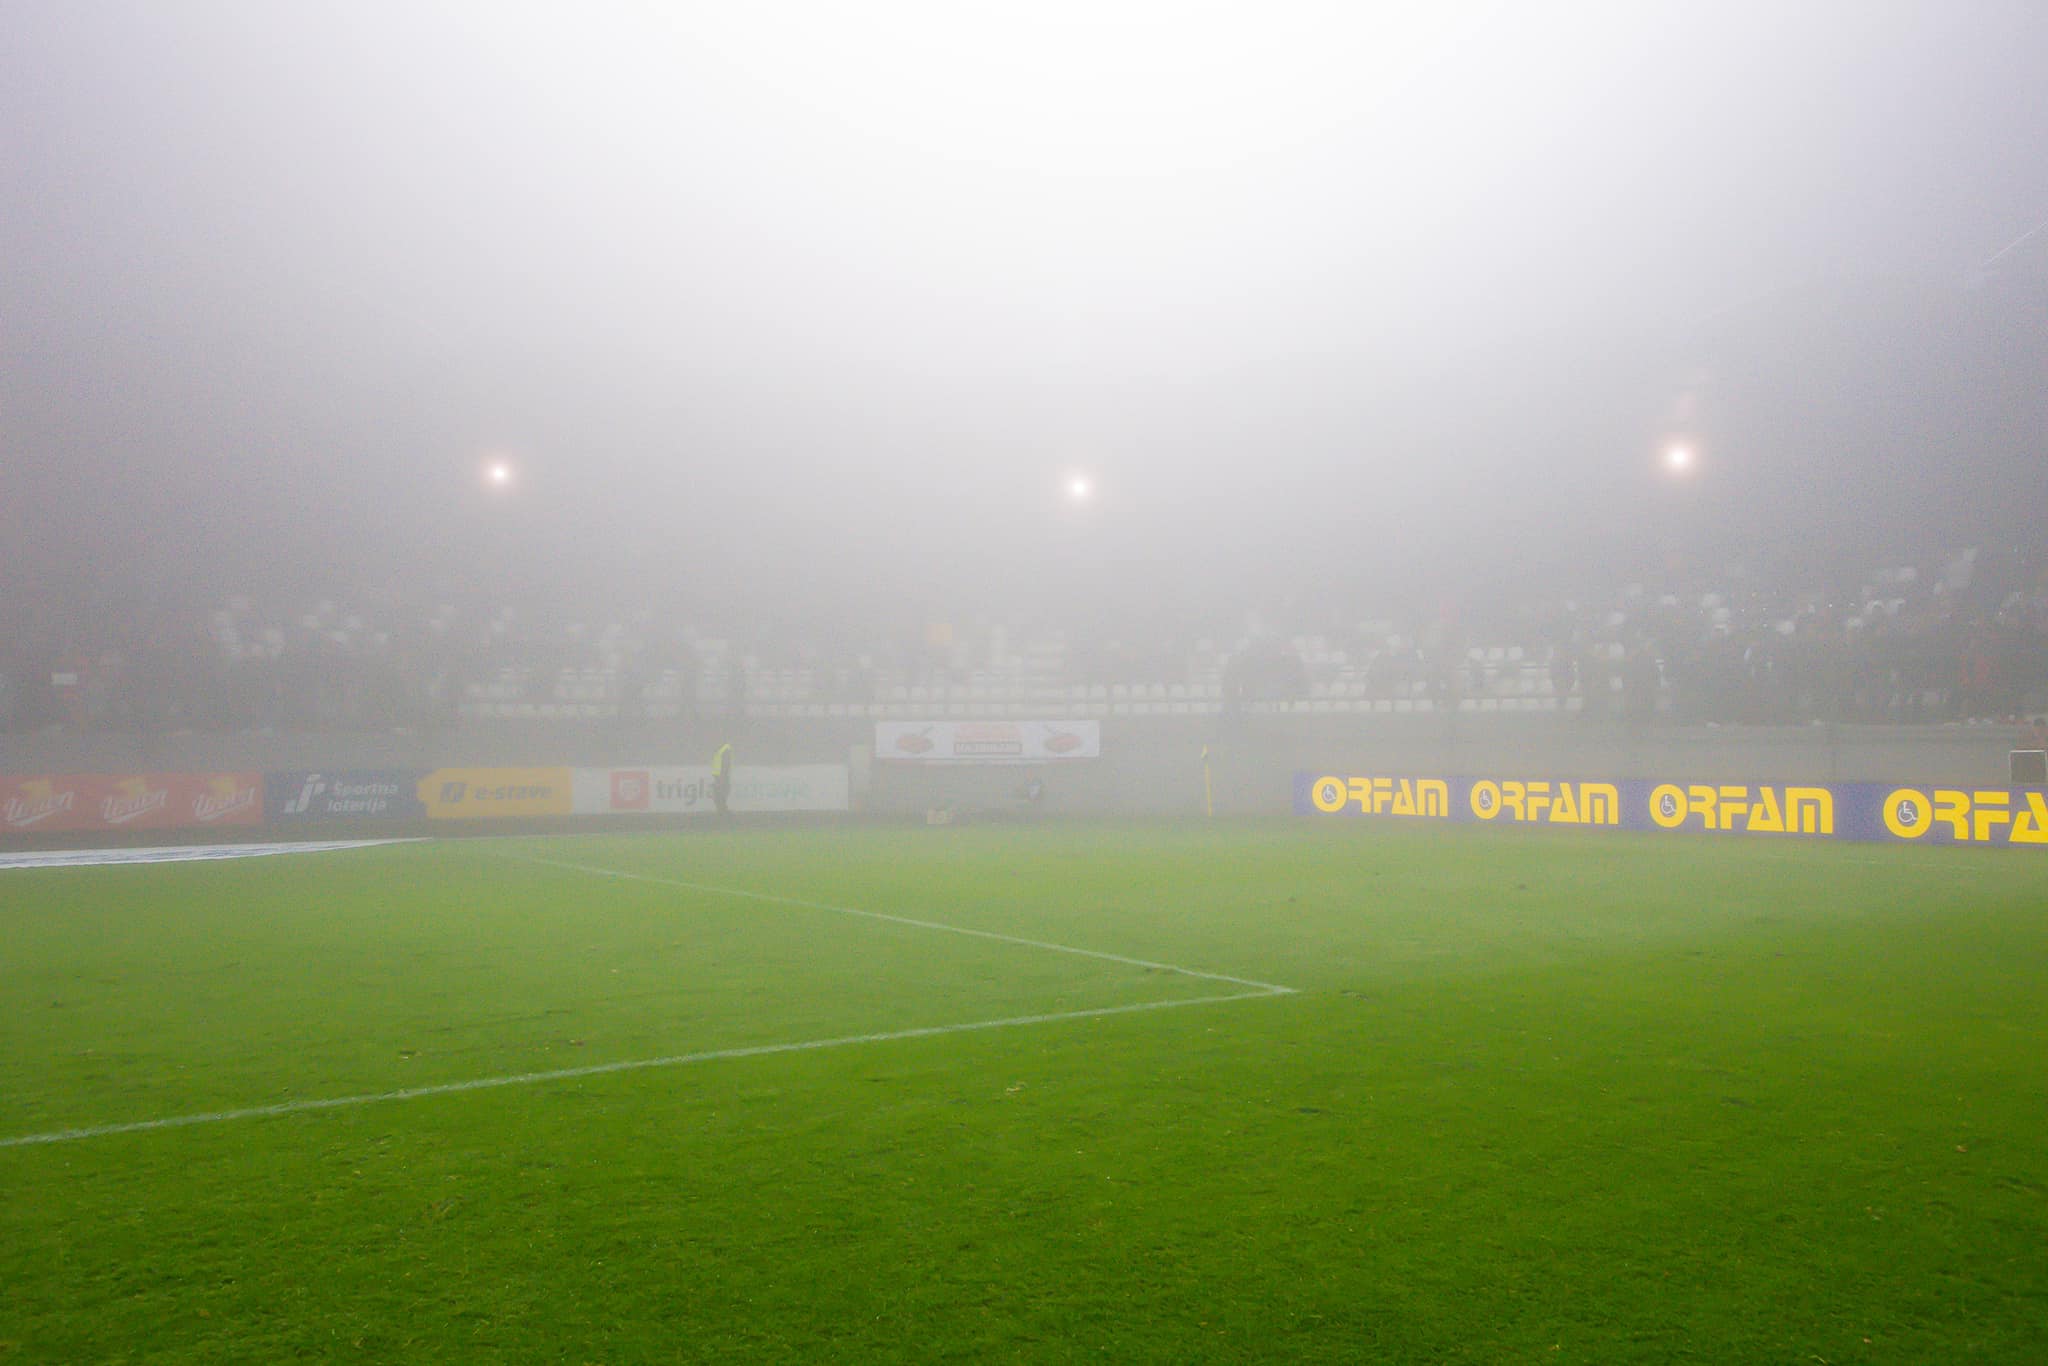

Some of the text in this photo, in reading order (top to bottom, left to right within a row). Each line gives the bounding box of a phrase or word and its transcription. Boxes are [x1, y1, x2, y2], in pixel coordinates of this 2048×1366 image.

[656, 778, 716, 806] trigla
[1312, 776, 1449, 817] ORFAM
[1470, 779, 1619, 825] ORFAM
[1649, 784, 1834, 835] ORFAM
